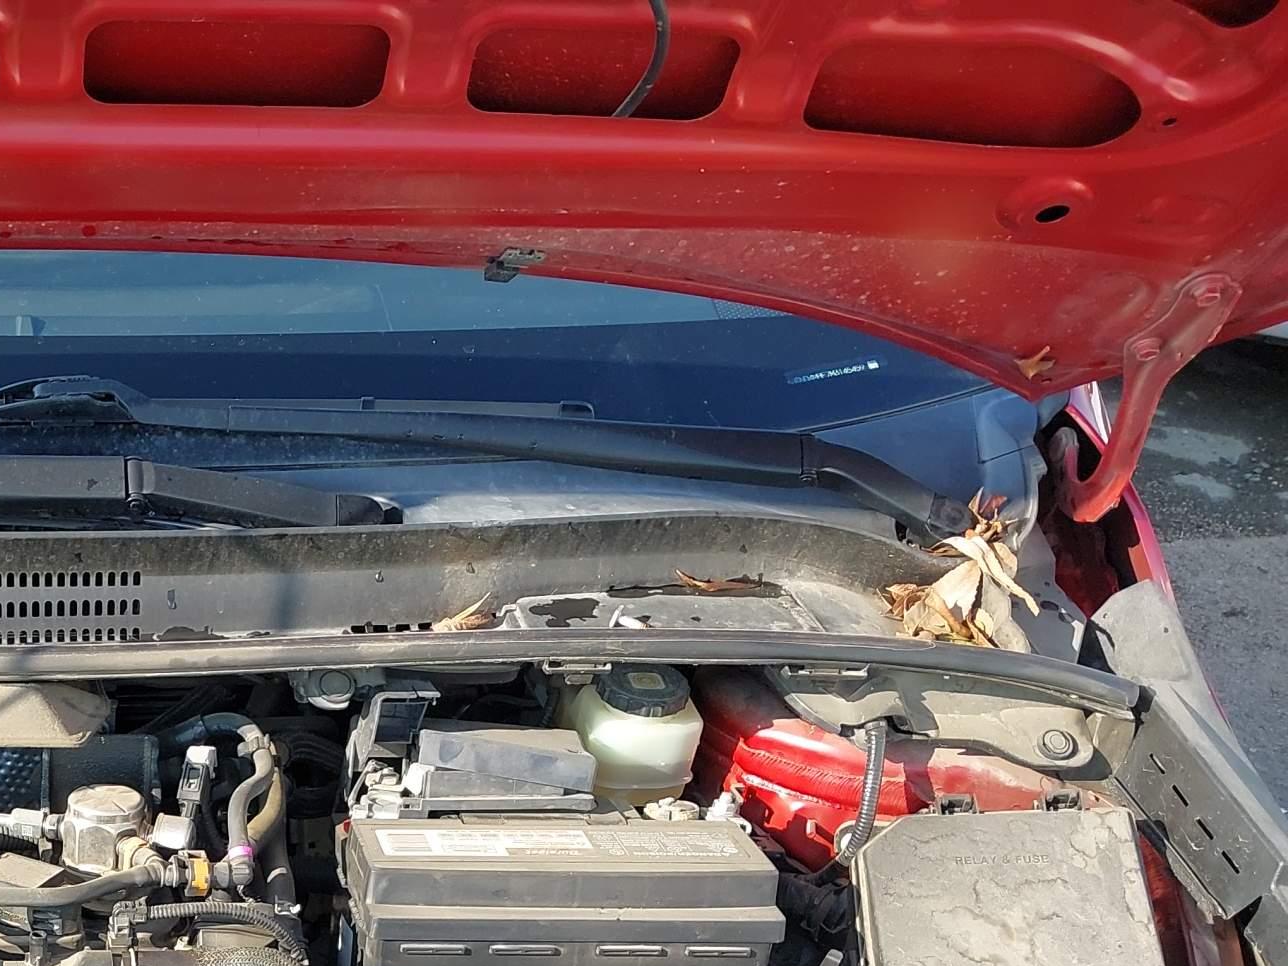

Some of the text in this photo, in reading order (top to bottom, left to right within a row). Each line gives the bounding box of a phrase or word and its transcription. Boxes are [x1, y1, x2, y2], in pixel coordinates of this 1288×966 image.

[954, 855, 1048, 865] RELAY & FUSE
